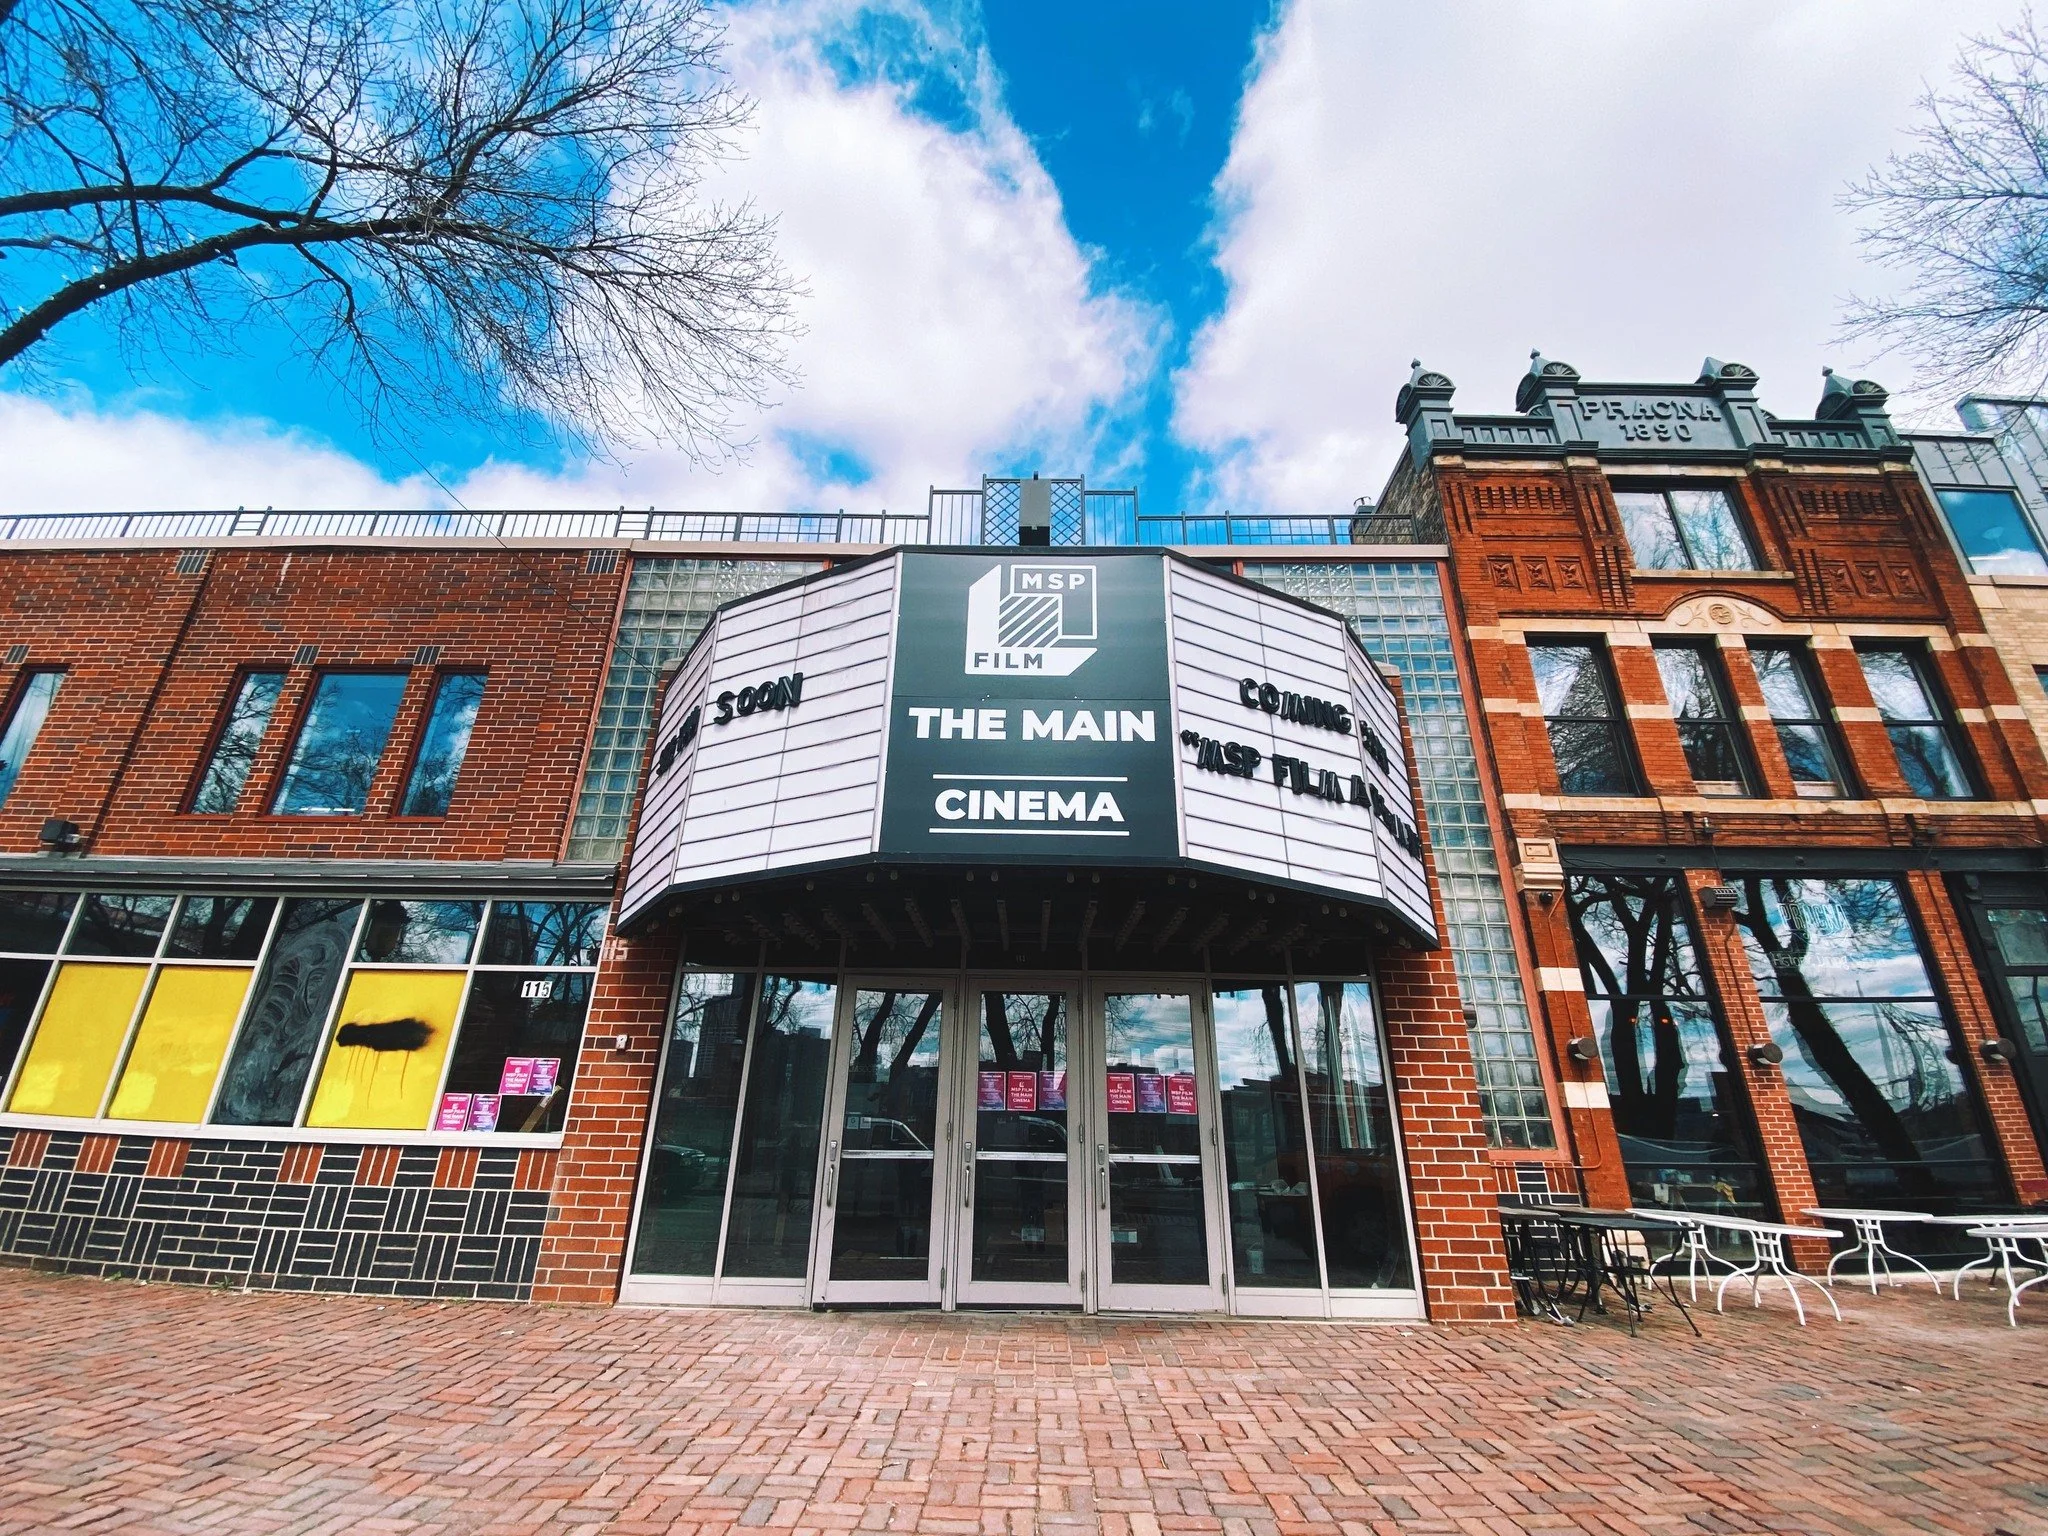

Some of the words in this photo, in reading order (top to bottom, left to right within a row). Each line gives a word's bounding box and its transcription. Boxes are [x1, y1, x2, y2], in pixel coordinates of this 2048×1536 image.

[1578, 400, 1721, 421] PRACNA
[1619, 424, 1692, 442] 1890
[1021, 573, 1086, 590] MSP
[973, 652, 1043, 669] FILM
[713, 672, 803, 725] SOON
[1240, 678, 1353, 735] COMING
[908, 707, 1007, 740] THE
[1022, 710, 1156, 742] MAIN
[1272, 753, 1345, 803] FILM
[934, 789, 1125, 822] CINEMA
[525, 981, 550, 997] 115
